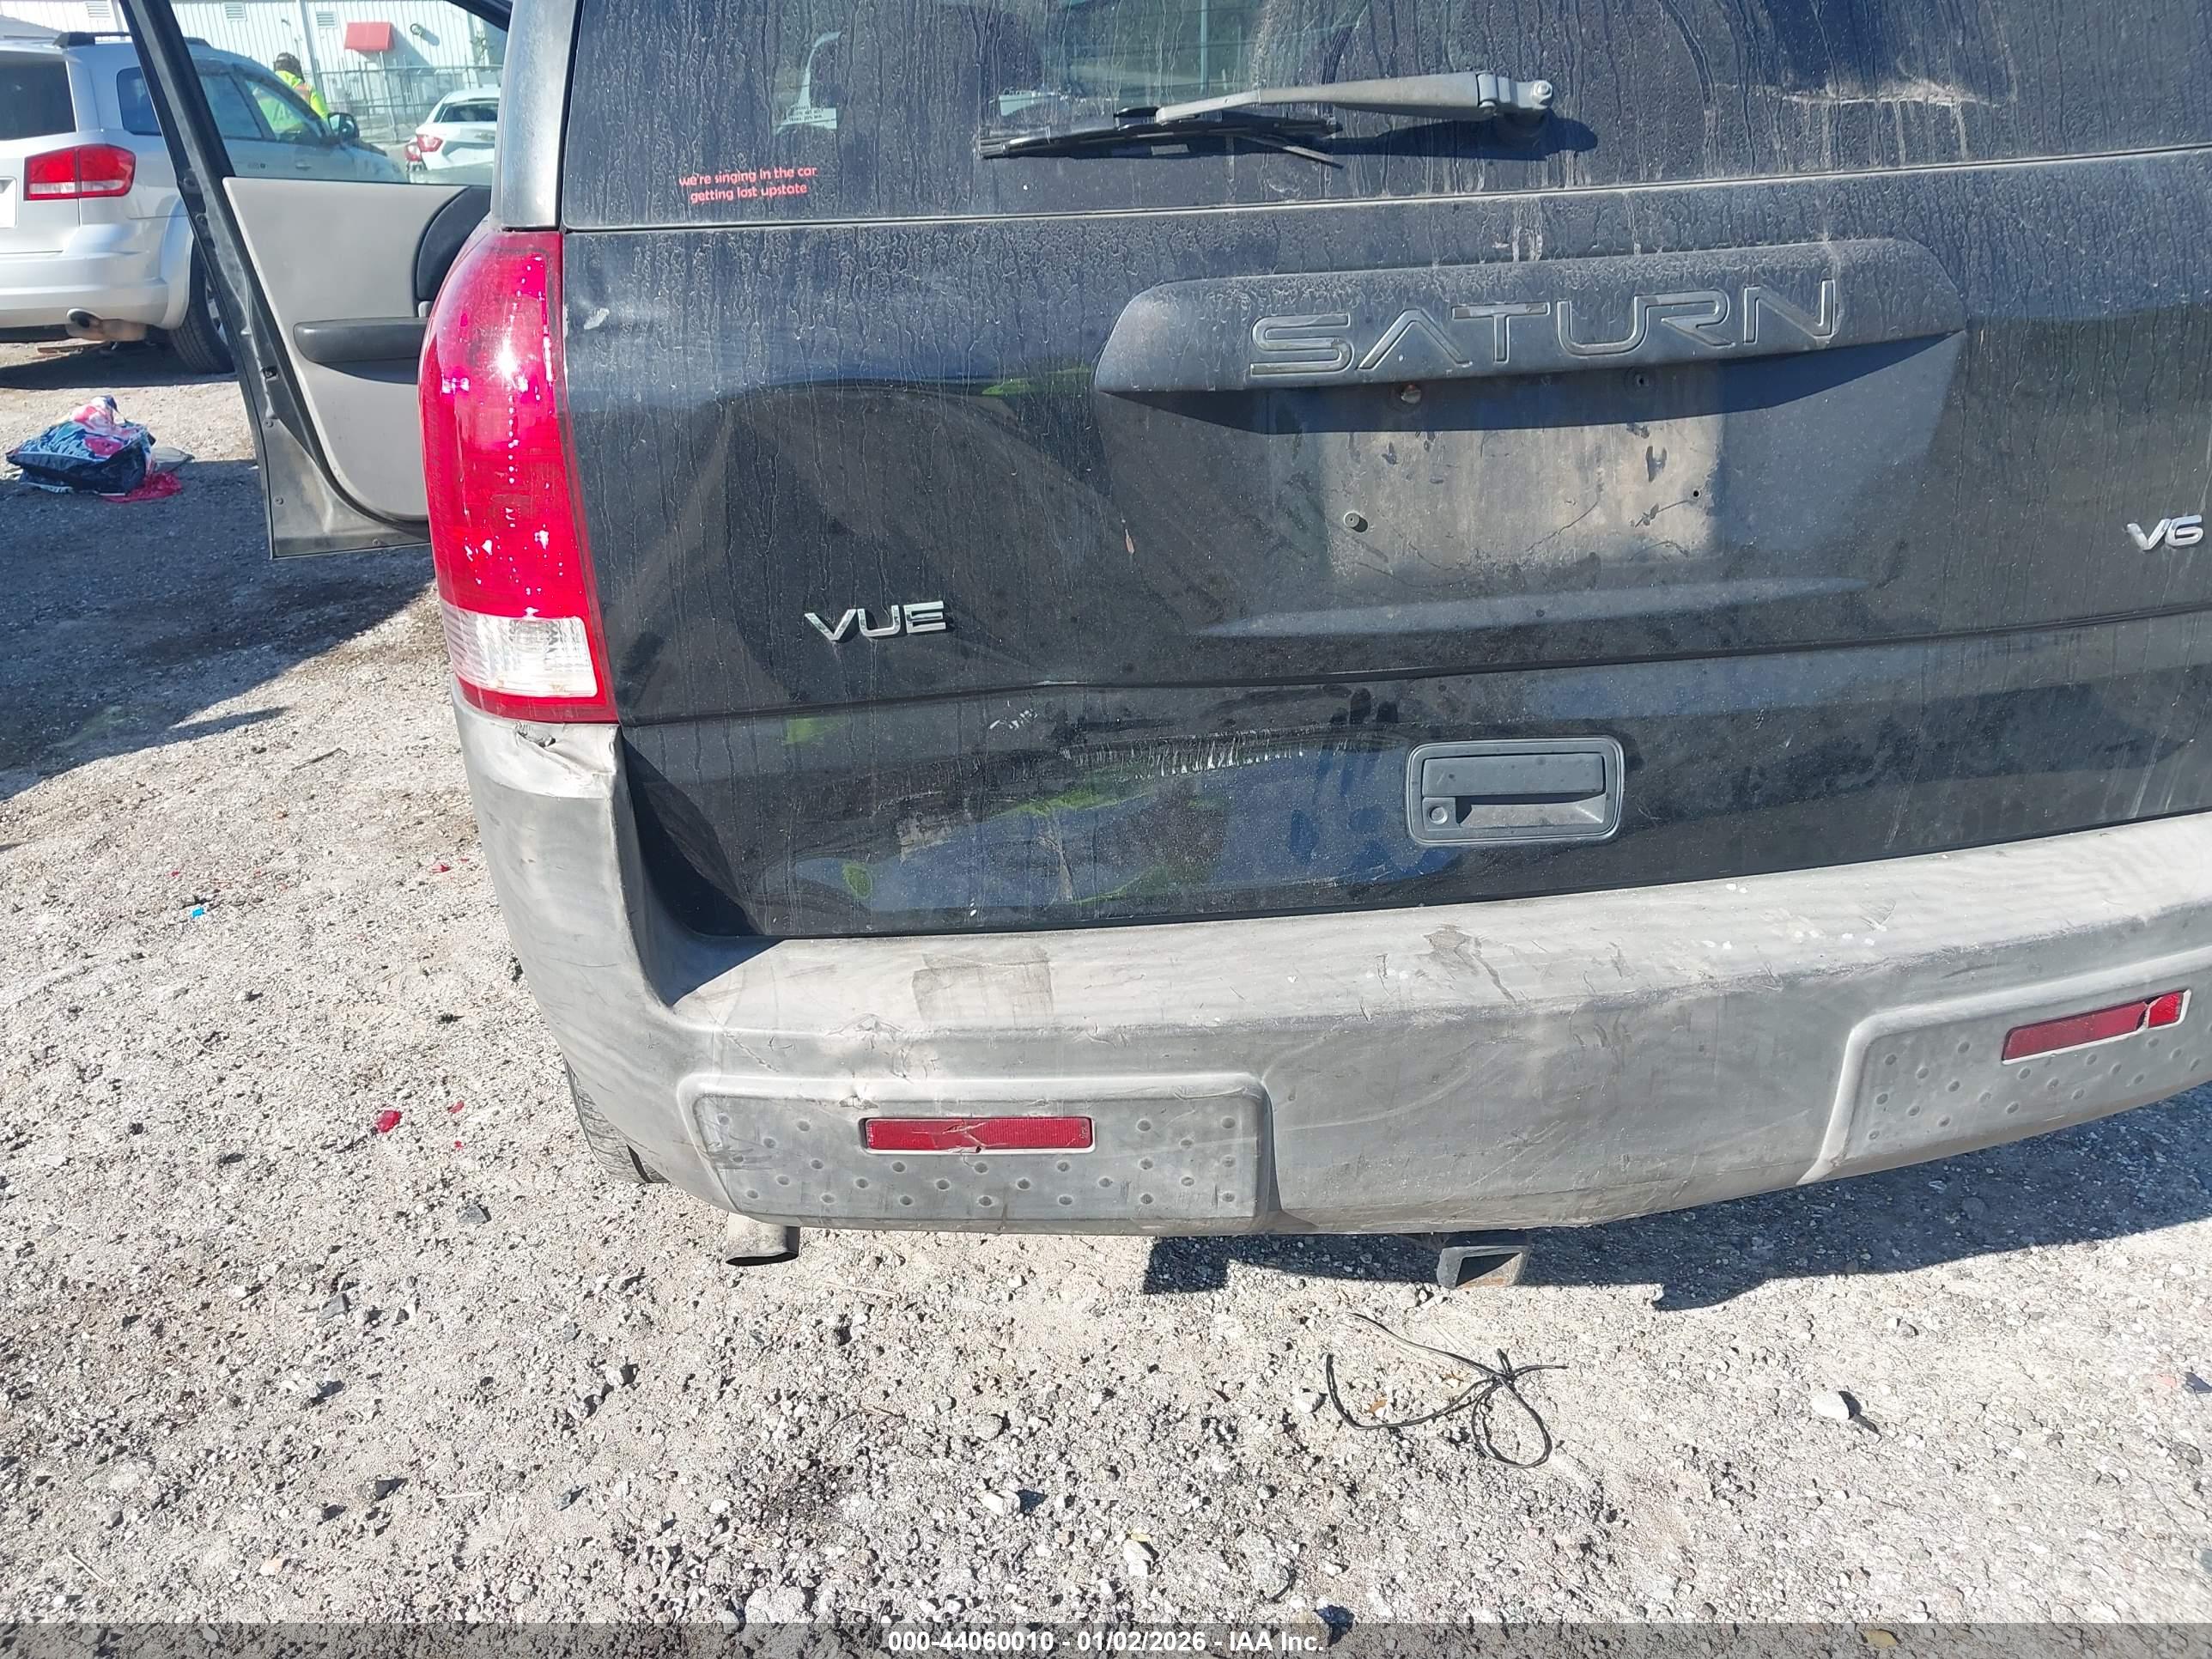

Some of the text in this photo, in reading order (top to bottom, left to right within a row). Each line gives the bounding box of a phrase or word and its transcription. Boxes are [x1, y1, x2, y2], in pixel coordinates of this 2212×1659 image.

[678, 173, 712, 186] we're
[714, 170, 757, 185] singing
[774, 167, 795, 179] the
[797, 167, 817, 177] car
[690, 183, 808, 204] getting lost upstate
[1250, 279, 1836, 376] SATURN
[2126, 514, 2204, 550] V6
[804, 600, 947, 641] VUE
